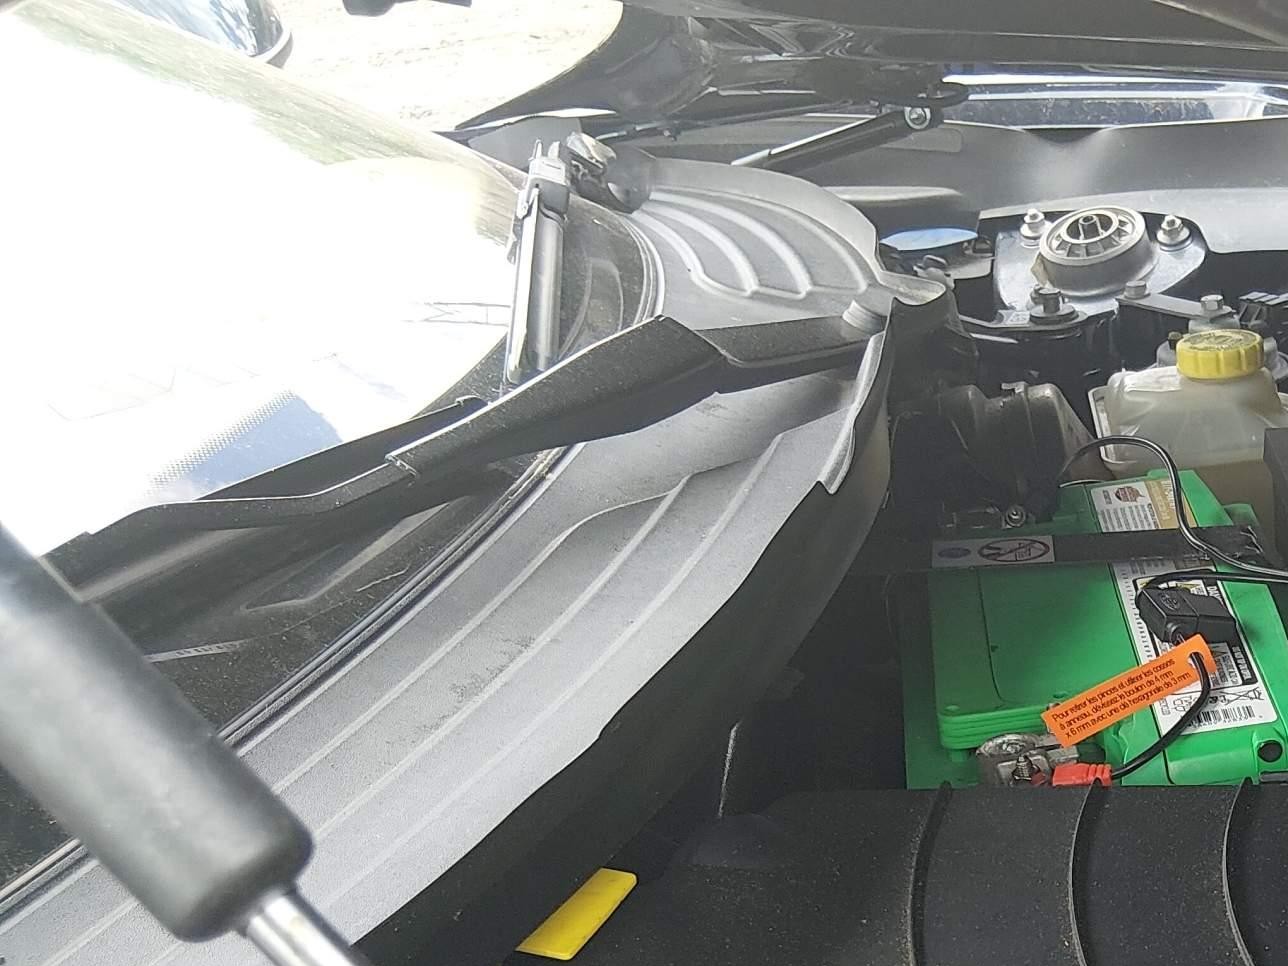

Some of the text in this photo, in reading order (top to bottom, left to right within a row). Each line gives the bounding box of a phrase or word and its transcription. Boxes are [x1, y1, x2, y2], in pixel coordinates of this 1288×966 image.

[1160, 671, 1174, 680] mm
[1051, 710, 1069, 721] Pour
[1097, 686, 1119, 701] pinces
[1076, 721, 1092, 732] mm
[1107, 707, 1120, 716] une
[1177, 672, 1191, 682] mm
